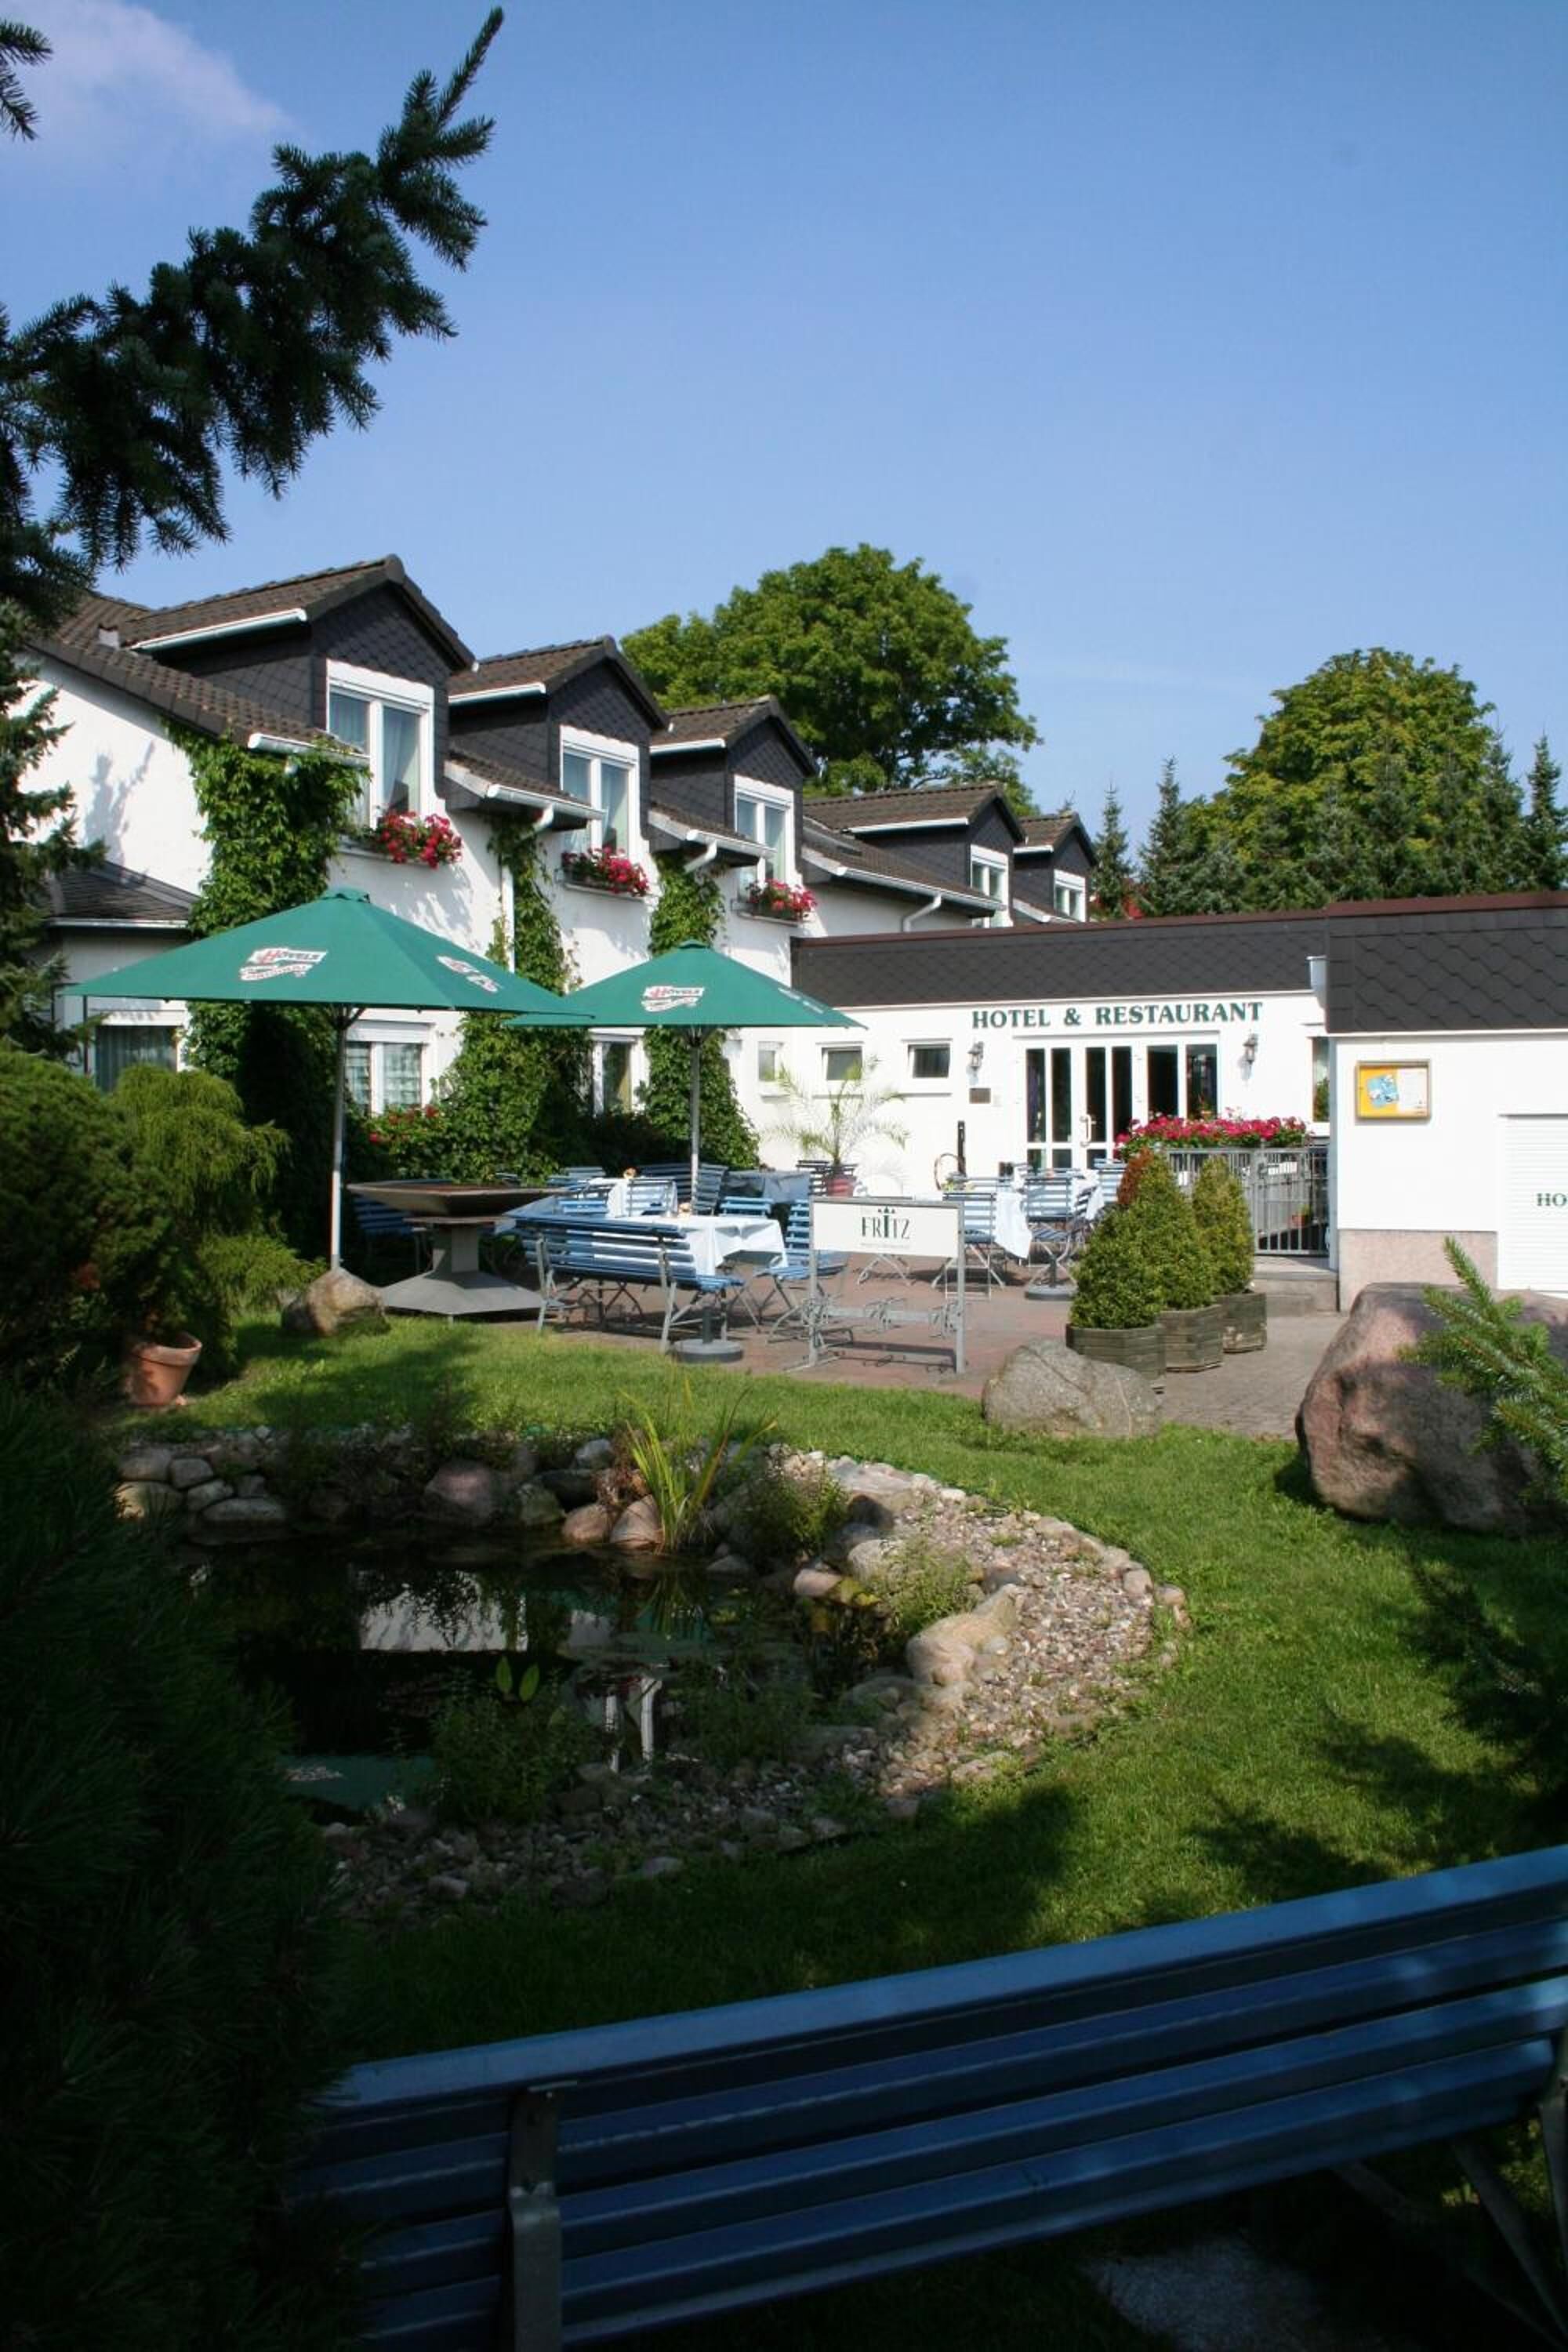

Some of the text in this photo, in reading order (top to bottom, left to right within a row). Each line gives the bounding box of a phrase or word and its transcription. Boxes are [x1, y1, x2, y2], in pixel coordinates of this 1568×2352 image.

[972, 1003, 1263, 1029] HOTEL & RESTAURANT
[861, 1215, 910, 1240] FRITZ
